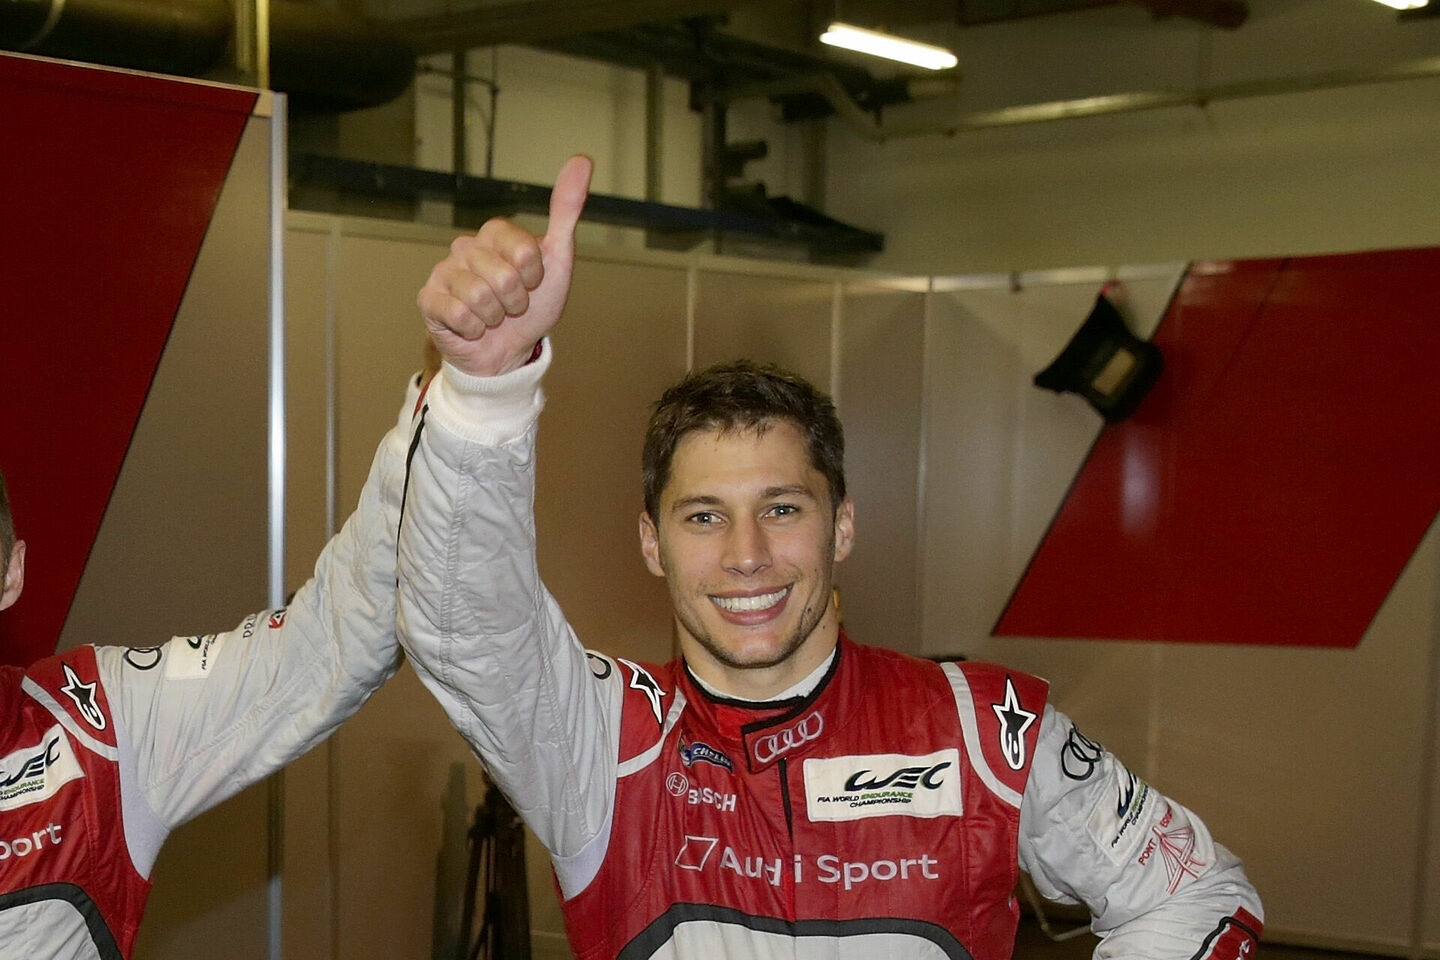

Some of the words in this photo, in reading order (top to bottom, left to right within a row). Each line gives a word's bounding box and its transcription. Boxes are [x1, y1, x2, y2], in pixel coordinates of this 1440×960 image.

[844, 762, 952, 791] WEC
[688, 787, 737, 812] BSCH
[832, 795, 860, 803] WORLD
[861, 791, 914, 800] ENDURANCE
[850, 798, 912, 808] CHAMPIONSHIP
[1138, 838, 1157, 866] PONT
[720, 846, 802, 886] Audi
[817, 854, 939, 890] Sport
